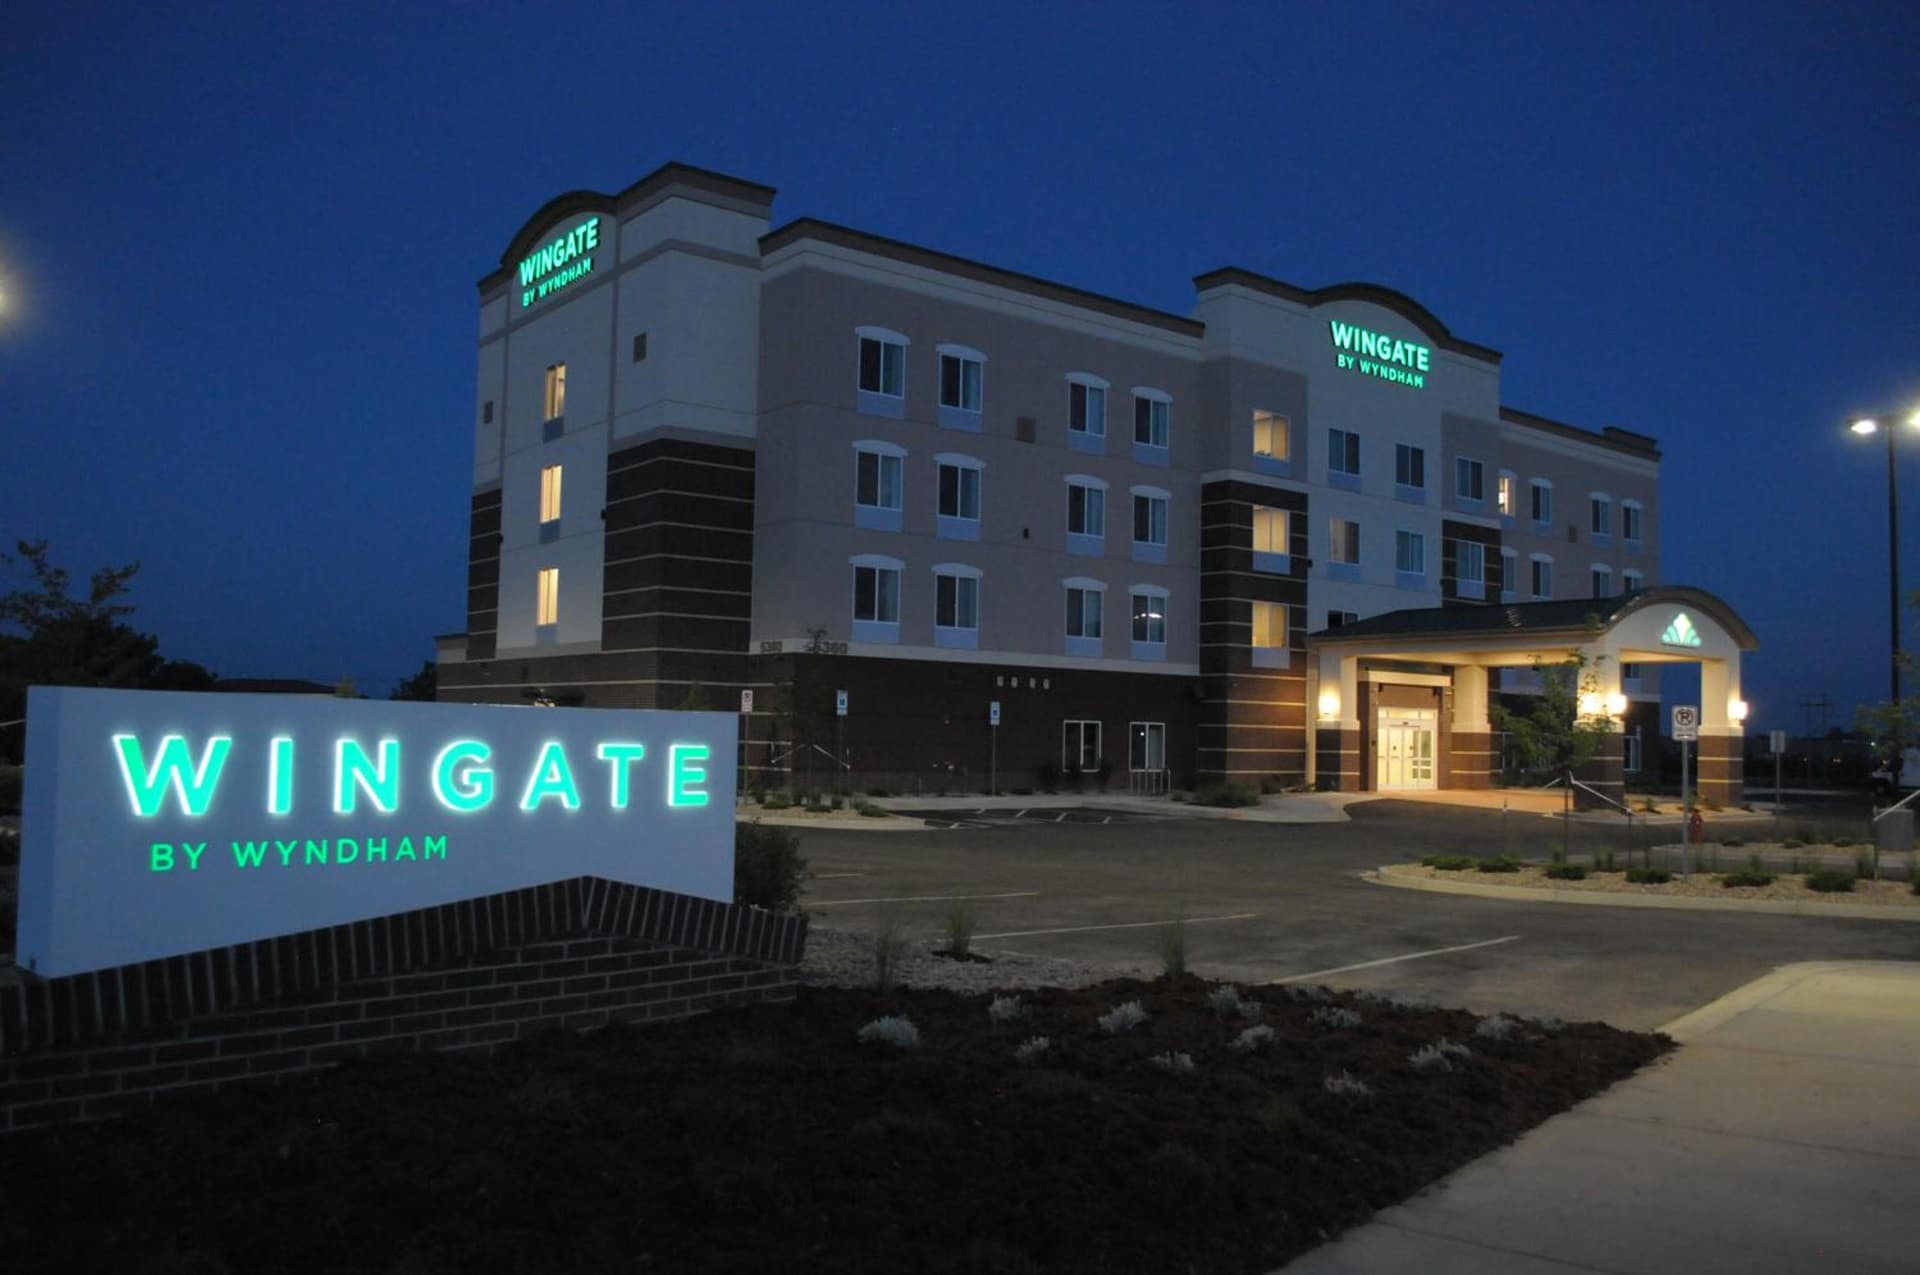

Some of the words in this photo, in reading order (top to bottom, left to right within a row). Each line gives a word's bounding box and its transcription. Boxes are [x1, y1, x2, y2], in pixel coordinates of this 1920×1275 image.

[520, 216, 599, 287] WINGATE
[523, 288, 536, 307] BY
[538, 257, 591, 298] WYNDHAM
[1330, 320, 1430, 372] WINGATE
[1337, 353, 1355, 369] BY
[1359, 359, 1424, 389] WYNDHAM
[112, 733, 710, 817] WINGATE
[150, 842, 207, 871] BY
[231, 835, 448, 868] WYNDHAM
